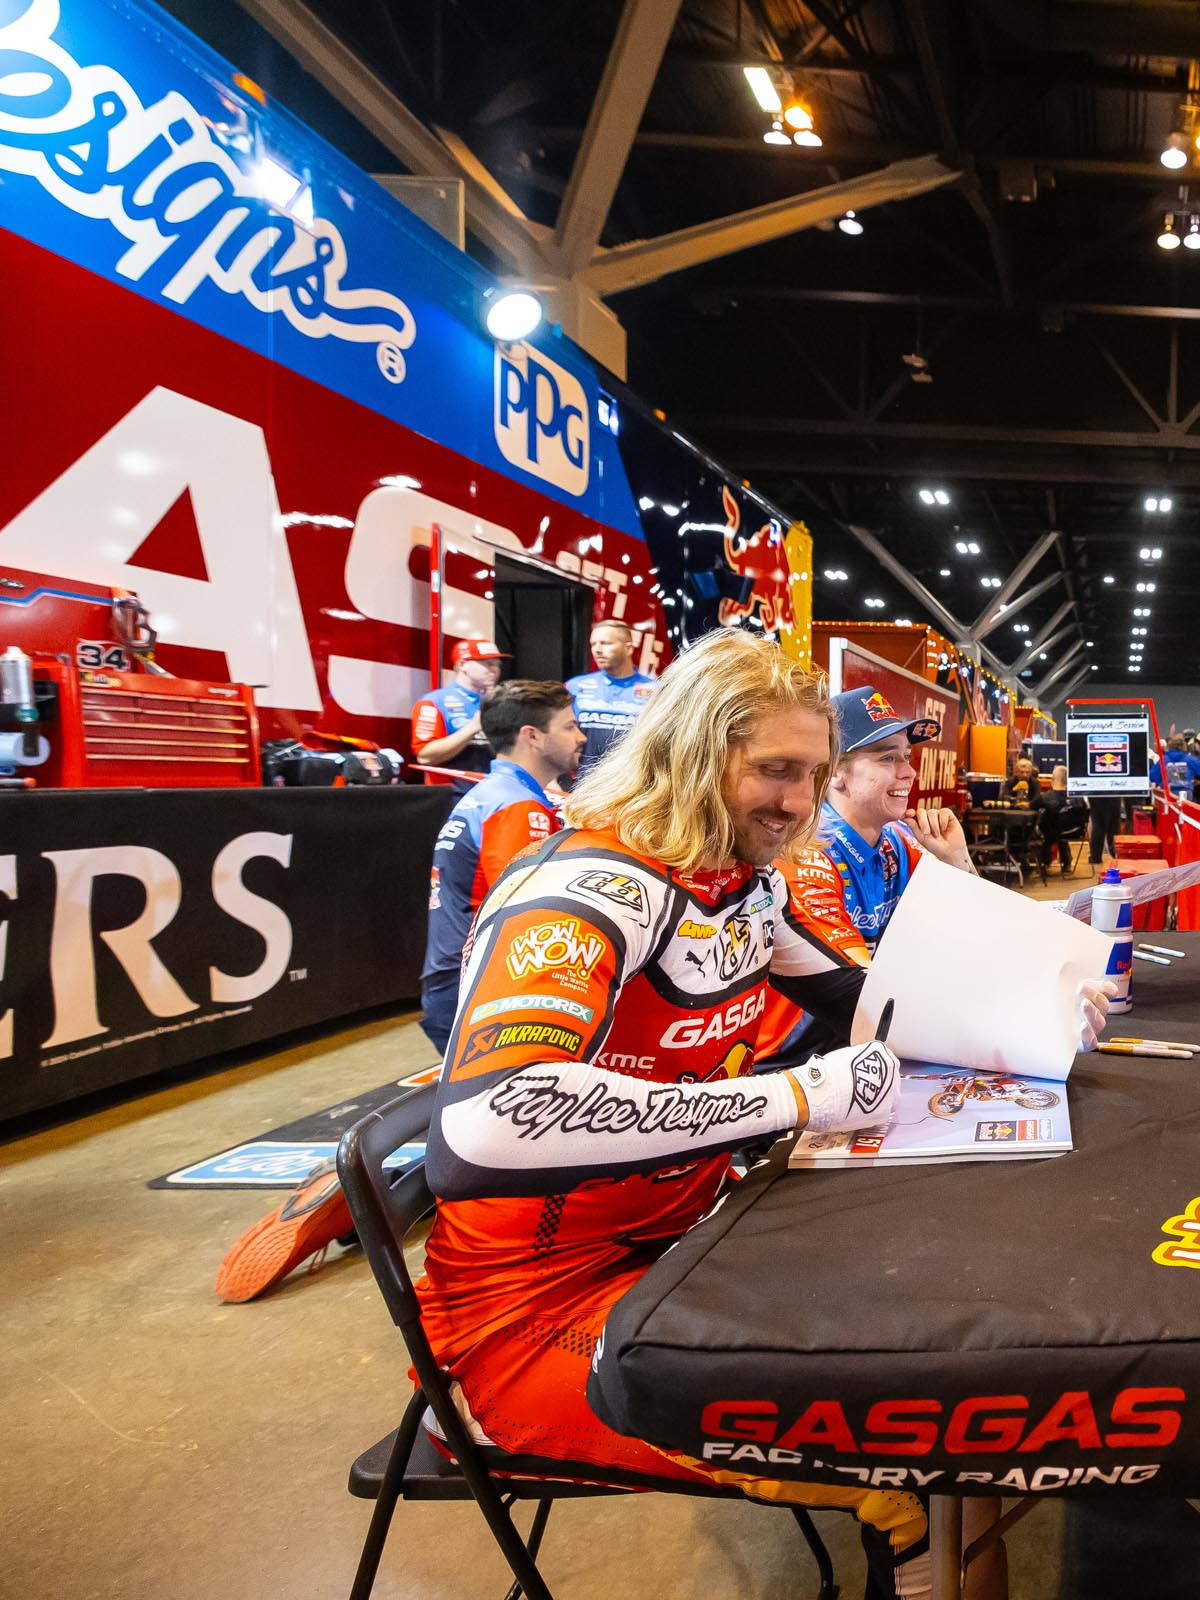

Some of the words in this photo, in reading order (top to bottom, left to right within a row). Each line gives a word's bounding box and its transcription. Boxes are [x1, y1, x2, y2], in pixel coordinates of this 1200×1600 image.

[500, 356, 583, 469] PPG
[78, 641, 128, 670] 34
[919, 747, 937, 790] ON
[938, 749, 957, 790] THE
[835, 830, 865, 864] GASGAS
[0, 830, 293, 1060] RS
[508, 936, 602, 977] WOW!
[513, 921, 576, 952] WOW
[499, 996, 589, 1022] MOTOREX
[490, 1076, 580, 1140] Troy
[560, 1082, 641, 1133] Lee
[637, 1087, 768, 1137] Designs
[701, 1387, 1186, 1456] GASGAS
